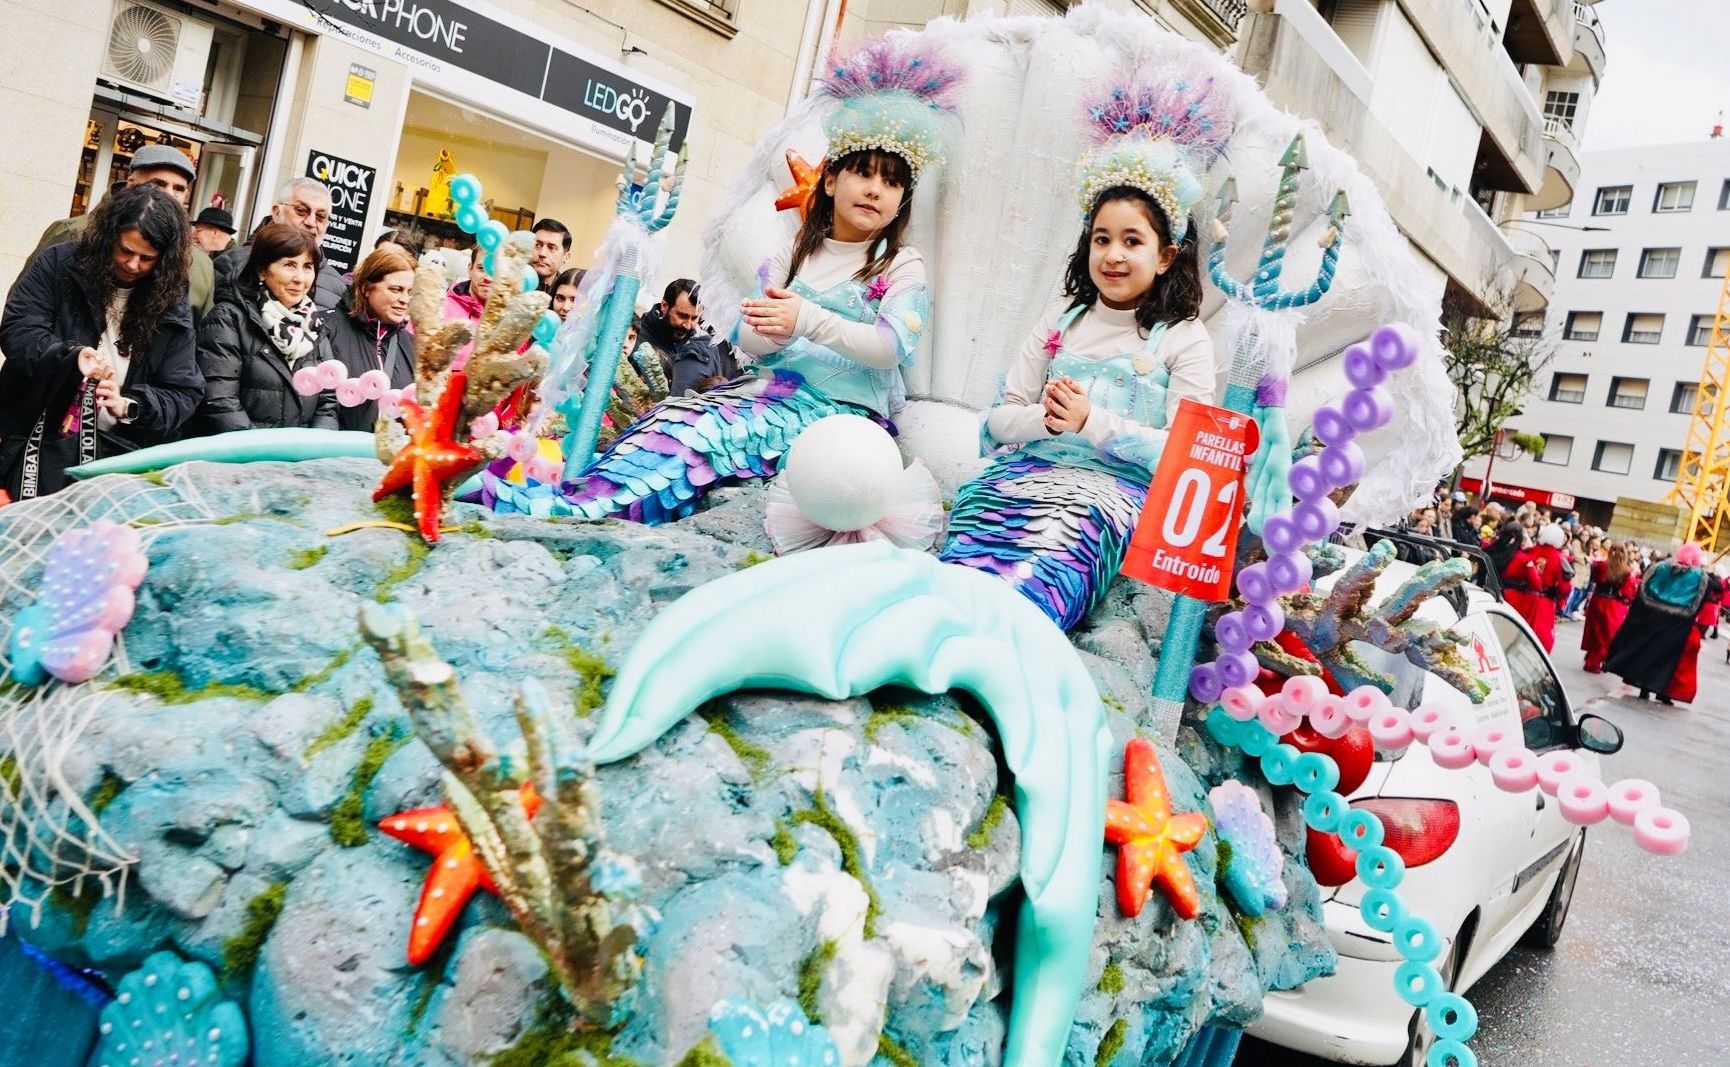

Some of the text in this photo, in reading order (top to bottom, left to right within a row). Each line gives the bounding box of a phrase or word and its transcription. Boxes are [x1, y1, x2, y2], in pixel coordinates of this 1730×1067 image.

[381, 0, 468, 53] PHONE
[394, 48, 442, 73] Accesorios
[583, 79, 647, 128] LEDGO
[312, 155, 371, 192] QUICK
[327, 184, 367, 214] ONE
[1195, 430, 1246, 456] PARELLAS
[1161, 467, 1239, 558] 02
[1152, 548, 1220, 585] Entroido
